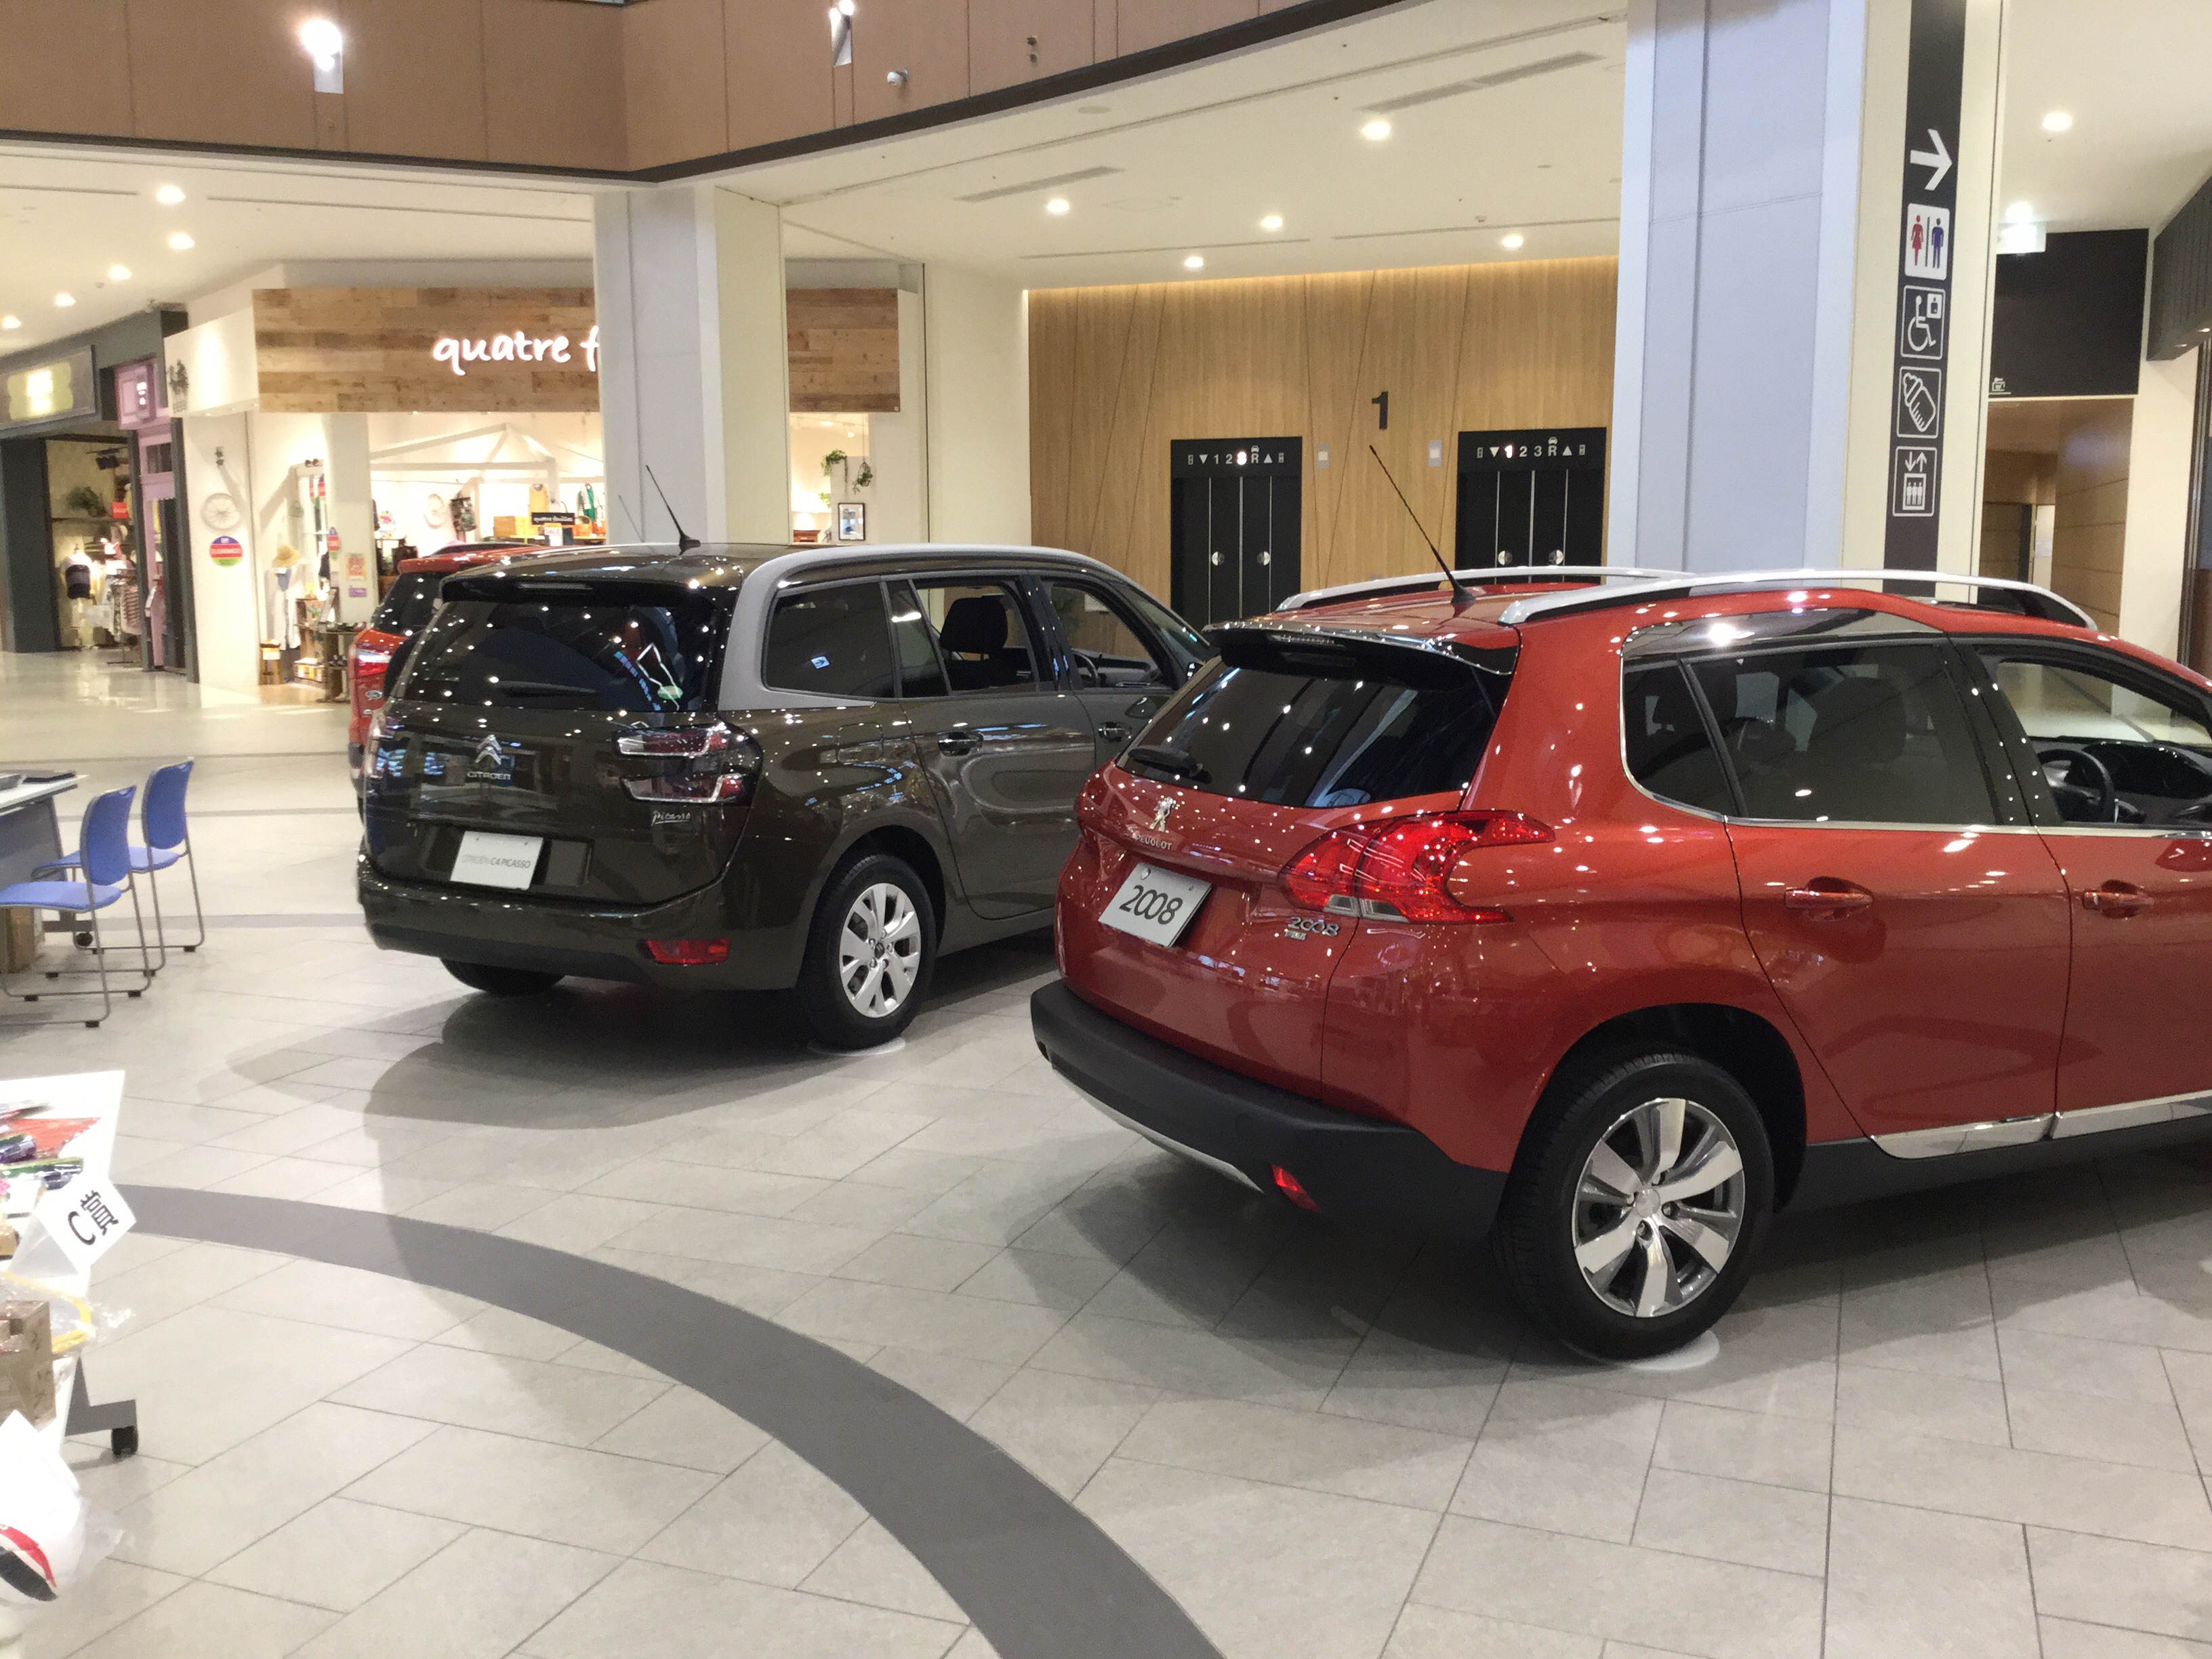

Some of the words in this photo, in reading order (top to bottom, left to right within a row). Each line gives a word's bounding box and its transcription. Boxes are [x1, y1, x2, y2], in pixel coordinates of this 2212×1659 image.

[432, 331, 571, 375] quatre
[1371, 391, 1389, 430] 1
[1214, 453, 1219, 465] 1
[1225, 453, 1233, 465] 2
[1251, 453, 1259, 464] R
[1504, 445, 1513, 459] 1
[1519, 446, 1528, 457] 2
[1534, 445, 1542, 457] 3
[1548, 445, 1557, 457] R
[1134, 832, 1172, 851] PEUGEOT
[1119, 884, 1183, 925] 2008
[1288, 916, 1339, 936] 2008
